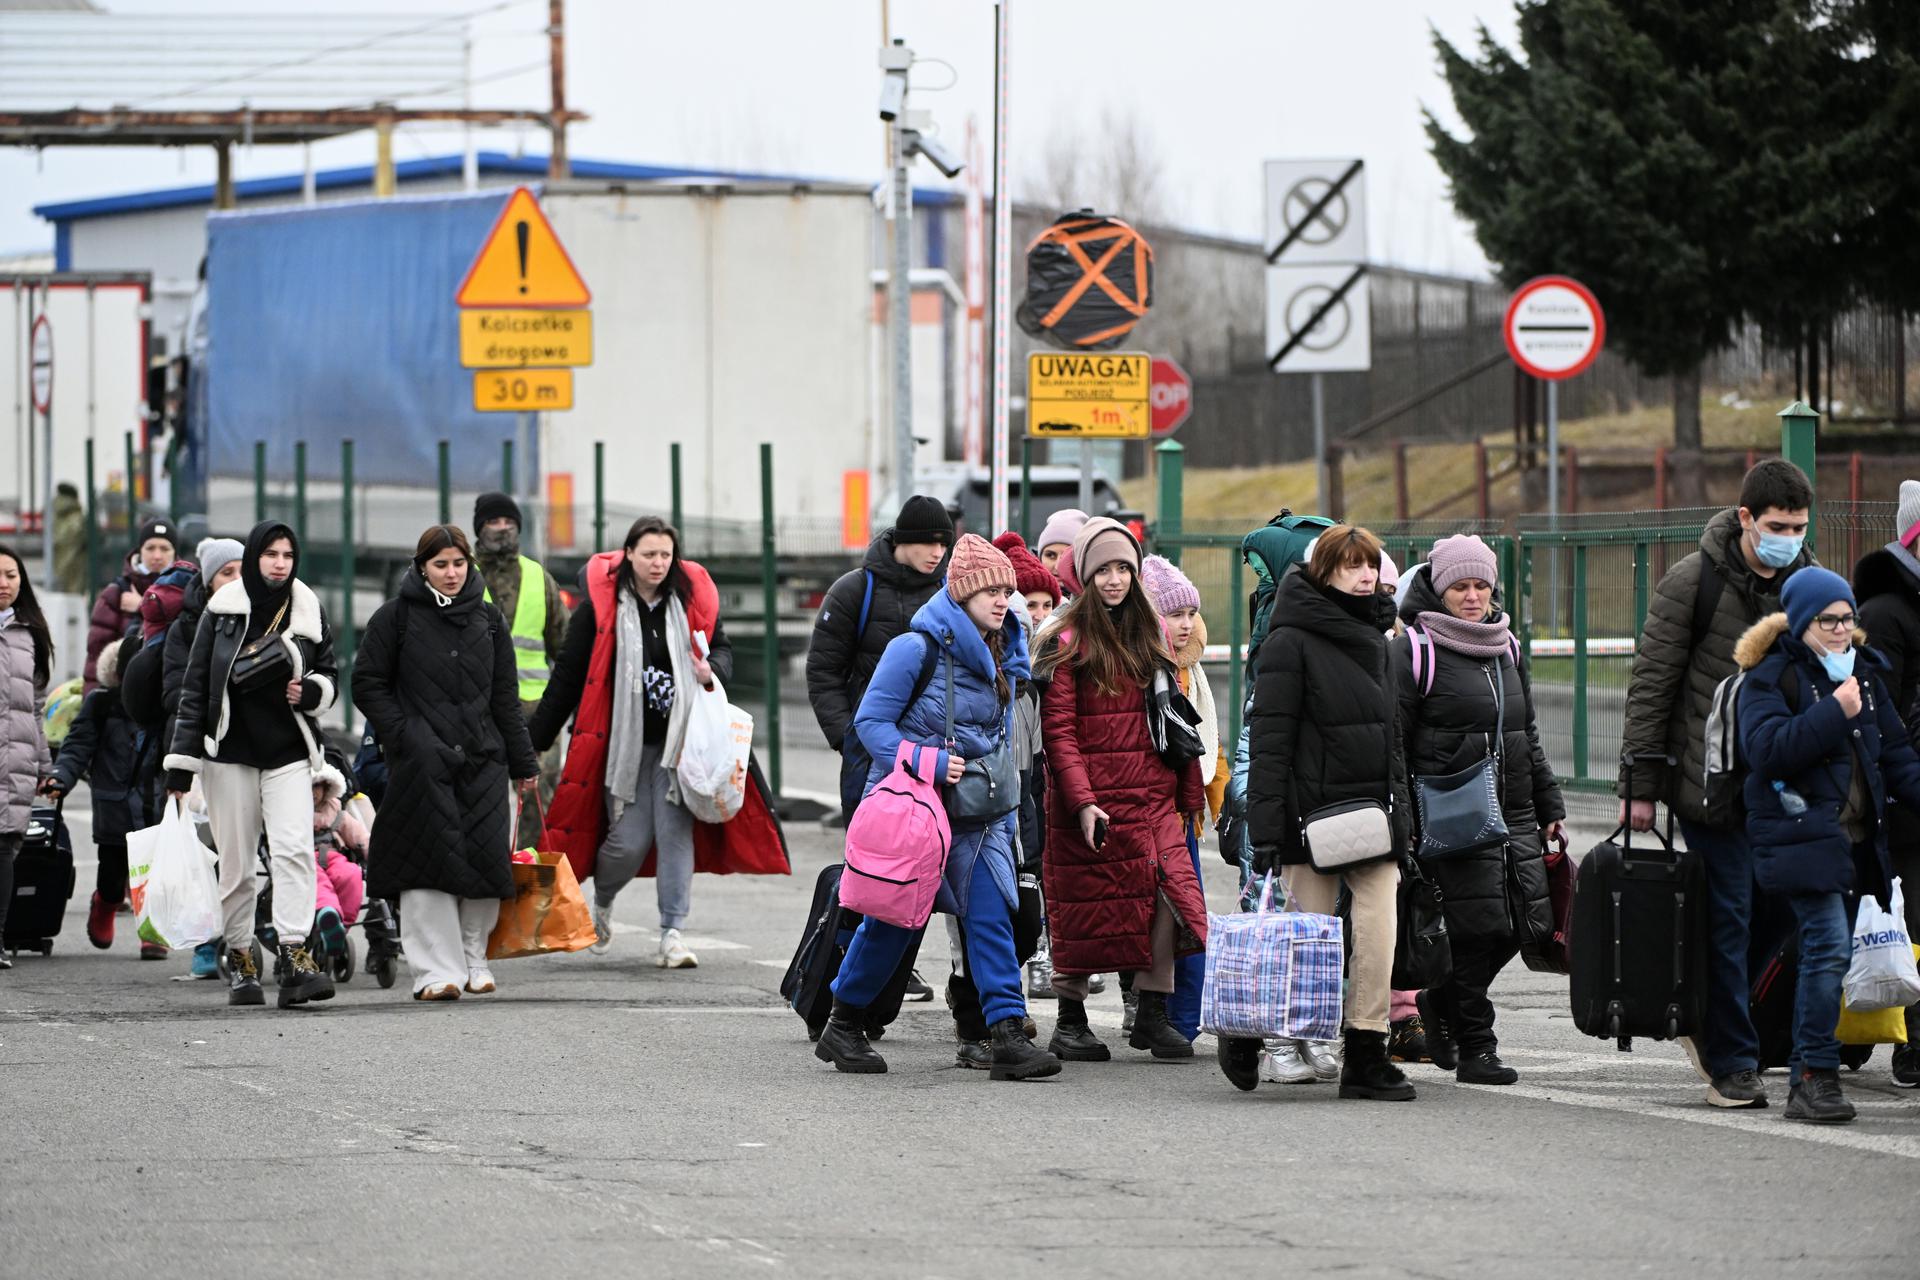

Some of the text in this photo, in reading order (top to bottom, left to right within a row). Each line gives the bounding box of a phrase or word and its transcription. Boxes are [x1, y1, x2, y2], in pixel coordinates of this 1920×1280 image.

[1039, 358, 1141, 377] UWAGA!
[493, 378, 558, 402] 30 m
